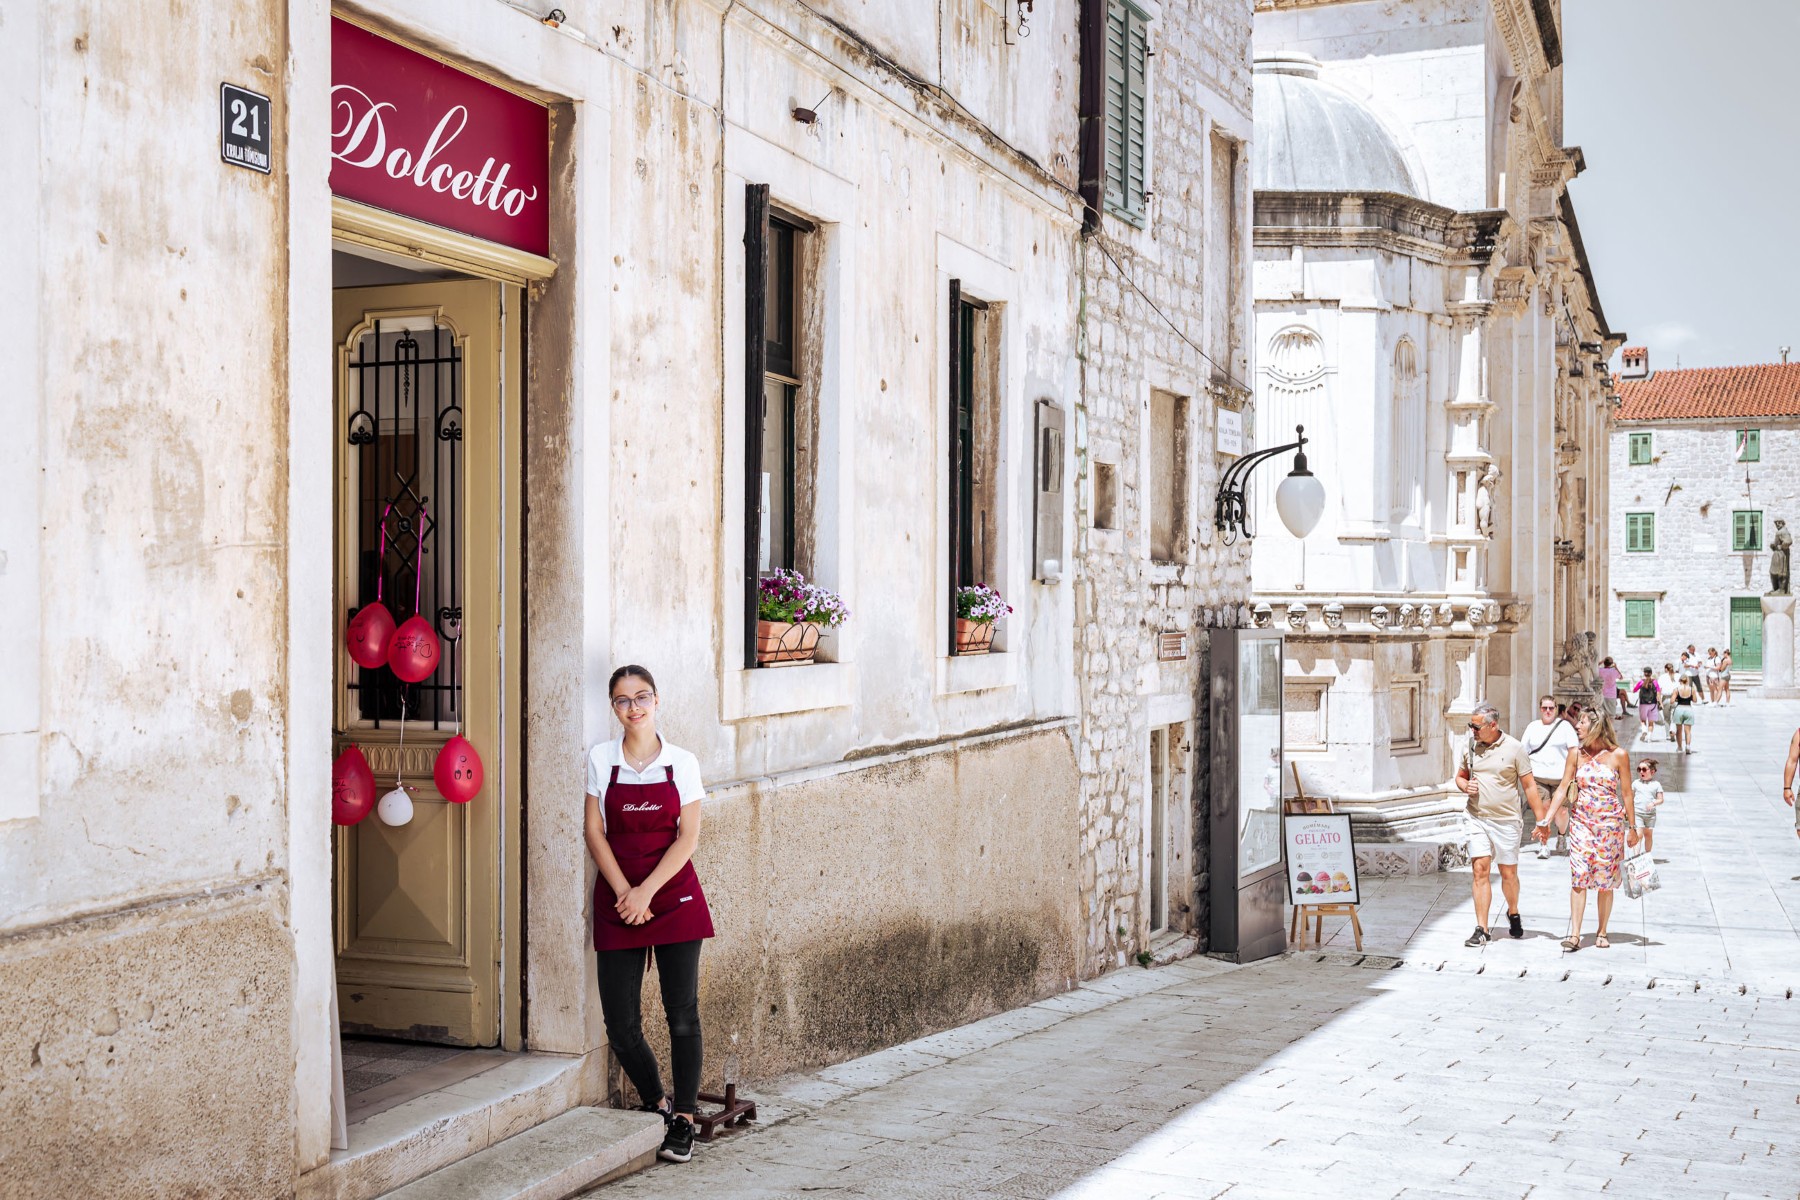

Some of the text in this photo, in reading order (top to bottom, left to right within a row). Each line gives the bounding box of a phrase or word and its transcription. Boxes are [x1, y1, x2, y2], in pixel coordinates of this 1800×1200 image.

[231, 99, 261, 141] 21
[331, 84, 538, 217] Dolcetto
[622, 801, 663, 812] Dolcetto
[1295, 832, 1341, 846] GELATO
